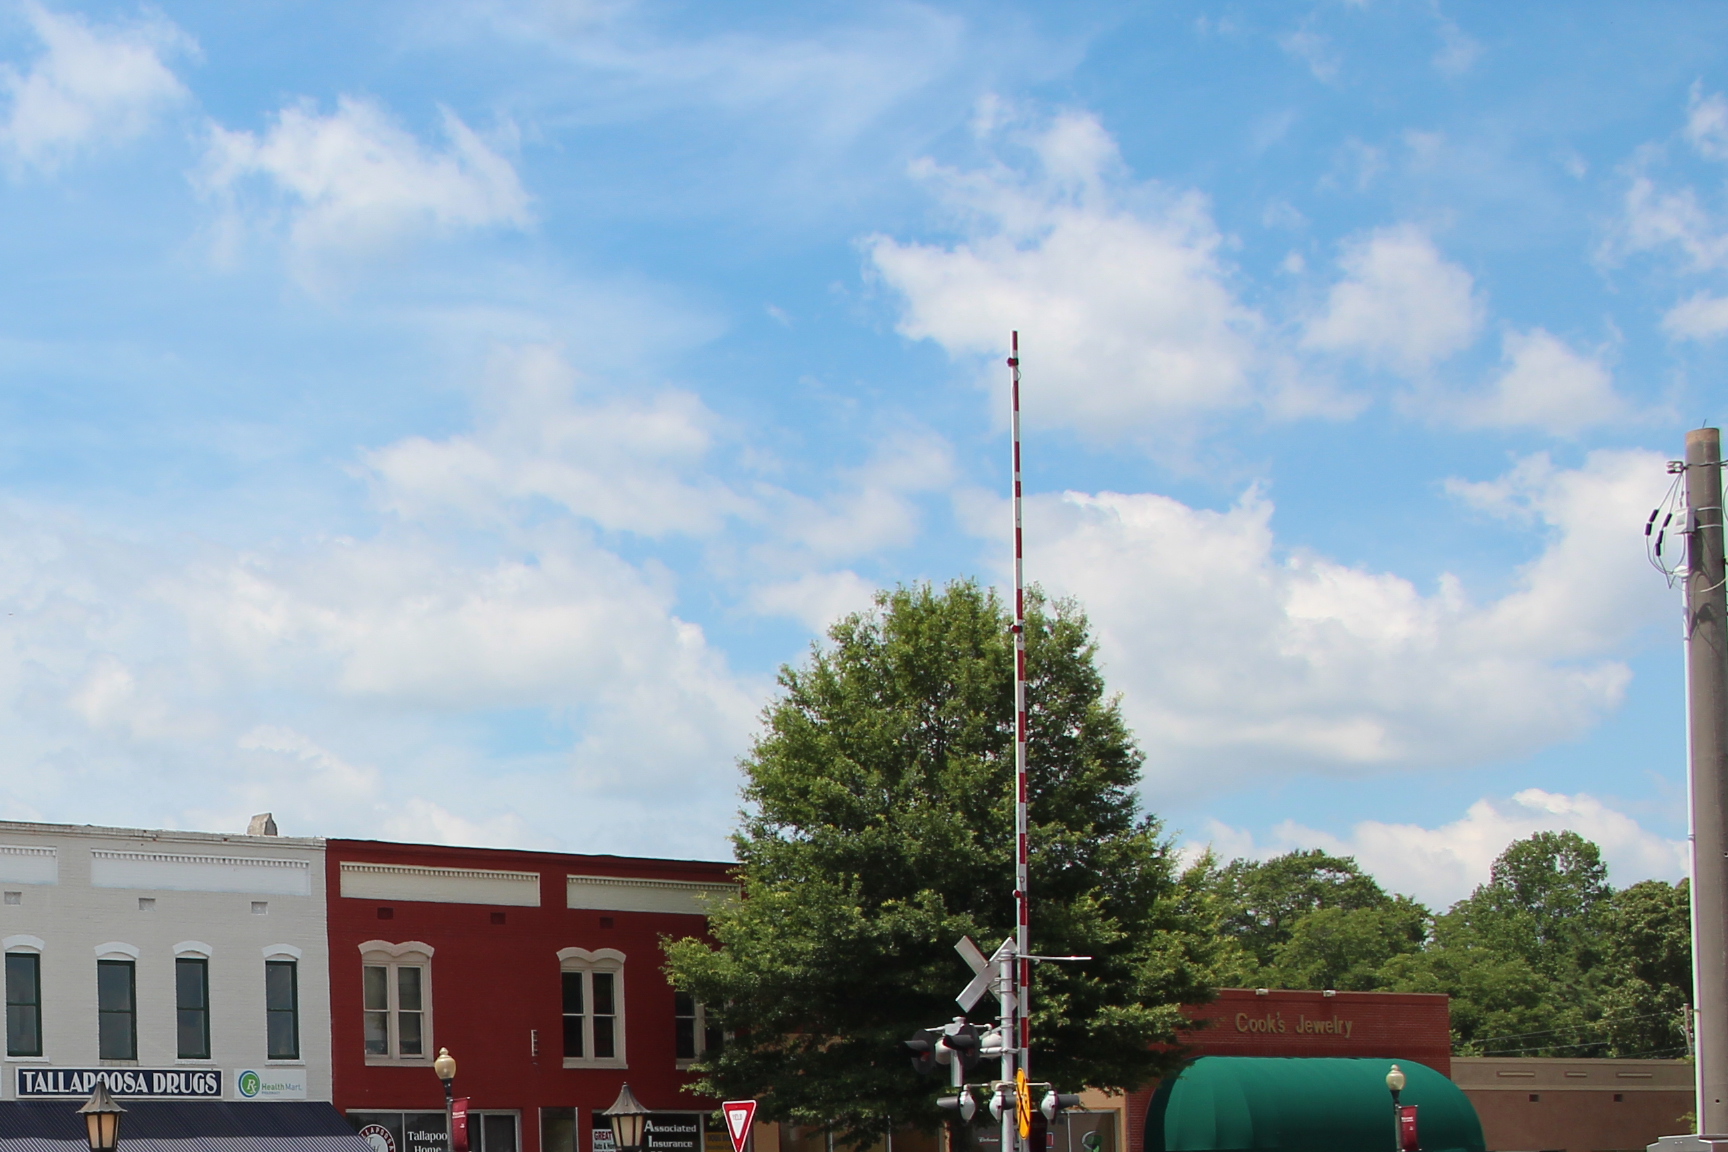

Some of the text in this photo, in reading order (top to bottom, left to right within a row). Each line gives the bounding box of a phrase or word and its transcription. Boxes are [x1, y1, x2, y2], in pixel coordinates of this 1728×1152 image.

[1235, 1011, 1352, 1039] Cook's Jewelry
[22, 1071, 218, 1094] TALLAPOOSA DRUGS
[644, 1120, 697, 1132] Associated
[407, 1131, 448, 1143] Tallapoo
[594, 1131, 612, 1140] GREAT
[648, 1135, 693, 1148] Insurance
